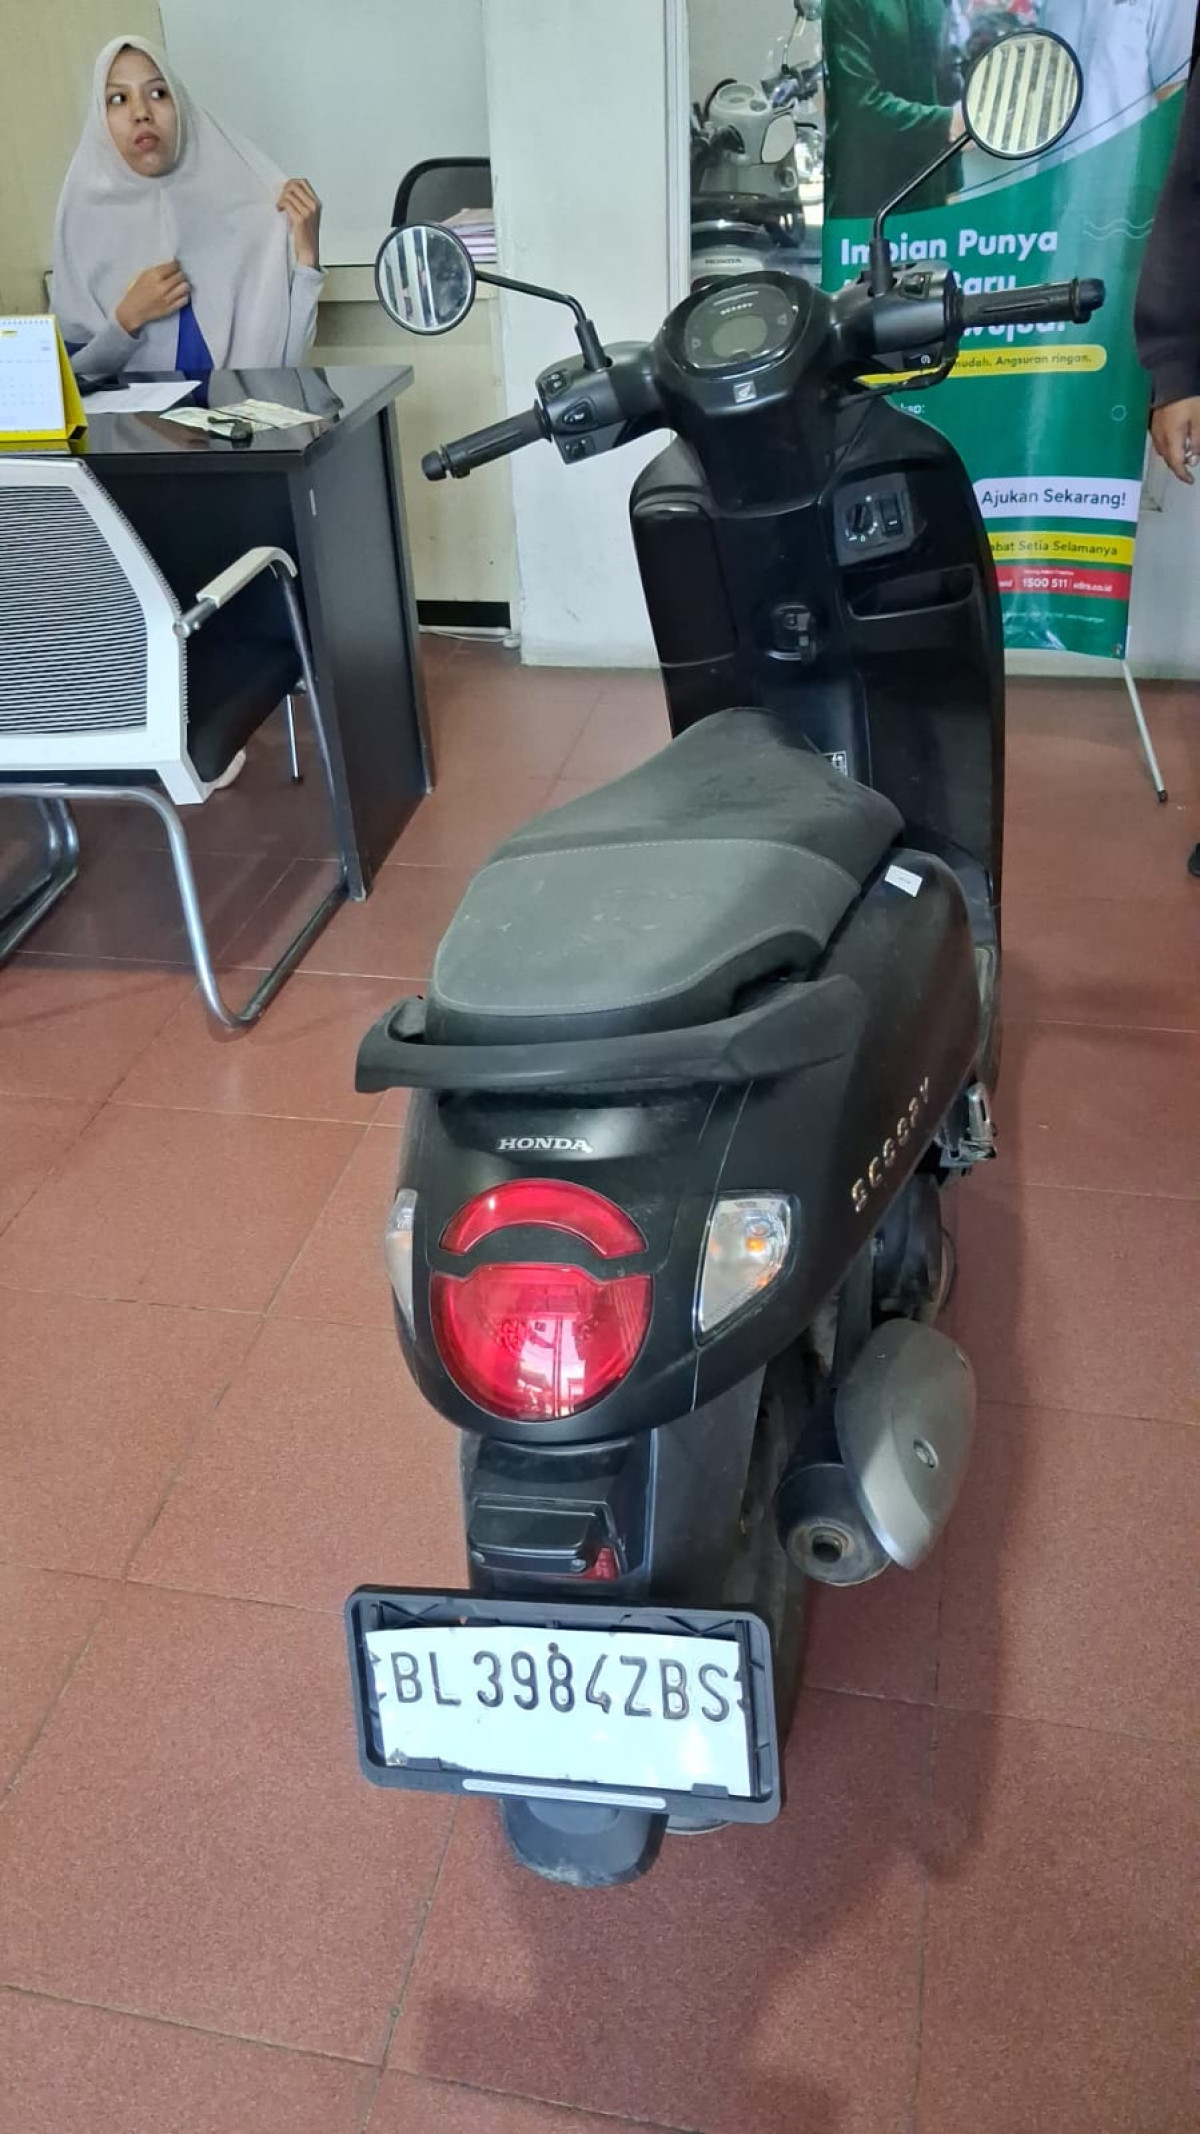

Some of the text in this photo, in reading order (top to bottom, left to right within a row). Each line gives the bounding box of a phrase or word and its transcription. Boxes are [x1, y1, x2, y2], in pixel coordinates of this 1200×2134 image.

[958, 228, 1058, 261] Punya
[953, 271, 1017, 296] aru
[995, 355, 1048, 368] Angsuran
[981, 488, 1126, 509] Ajukan Sekarang!
[991, 540, 1118, 557] abat Setia Selamanya
[1023, 578, 1049, 588] 1500
[1051, 578, 1068, 588] 511
[498, 1137, 592, 1153] HONDA
[390, 1651, 462, 1706] BL
